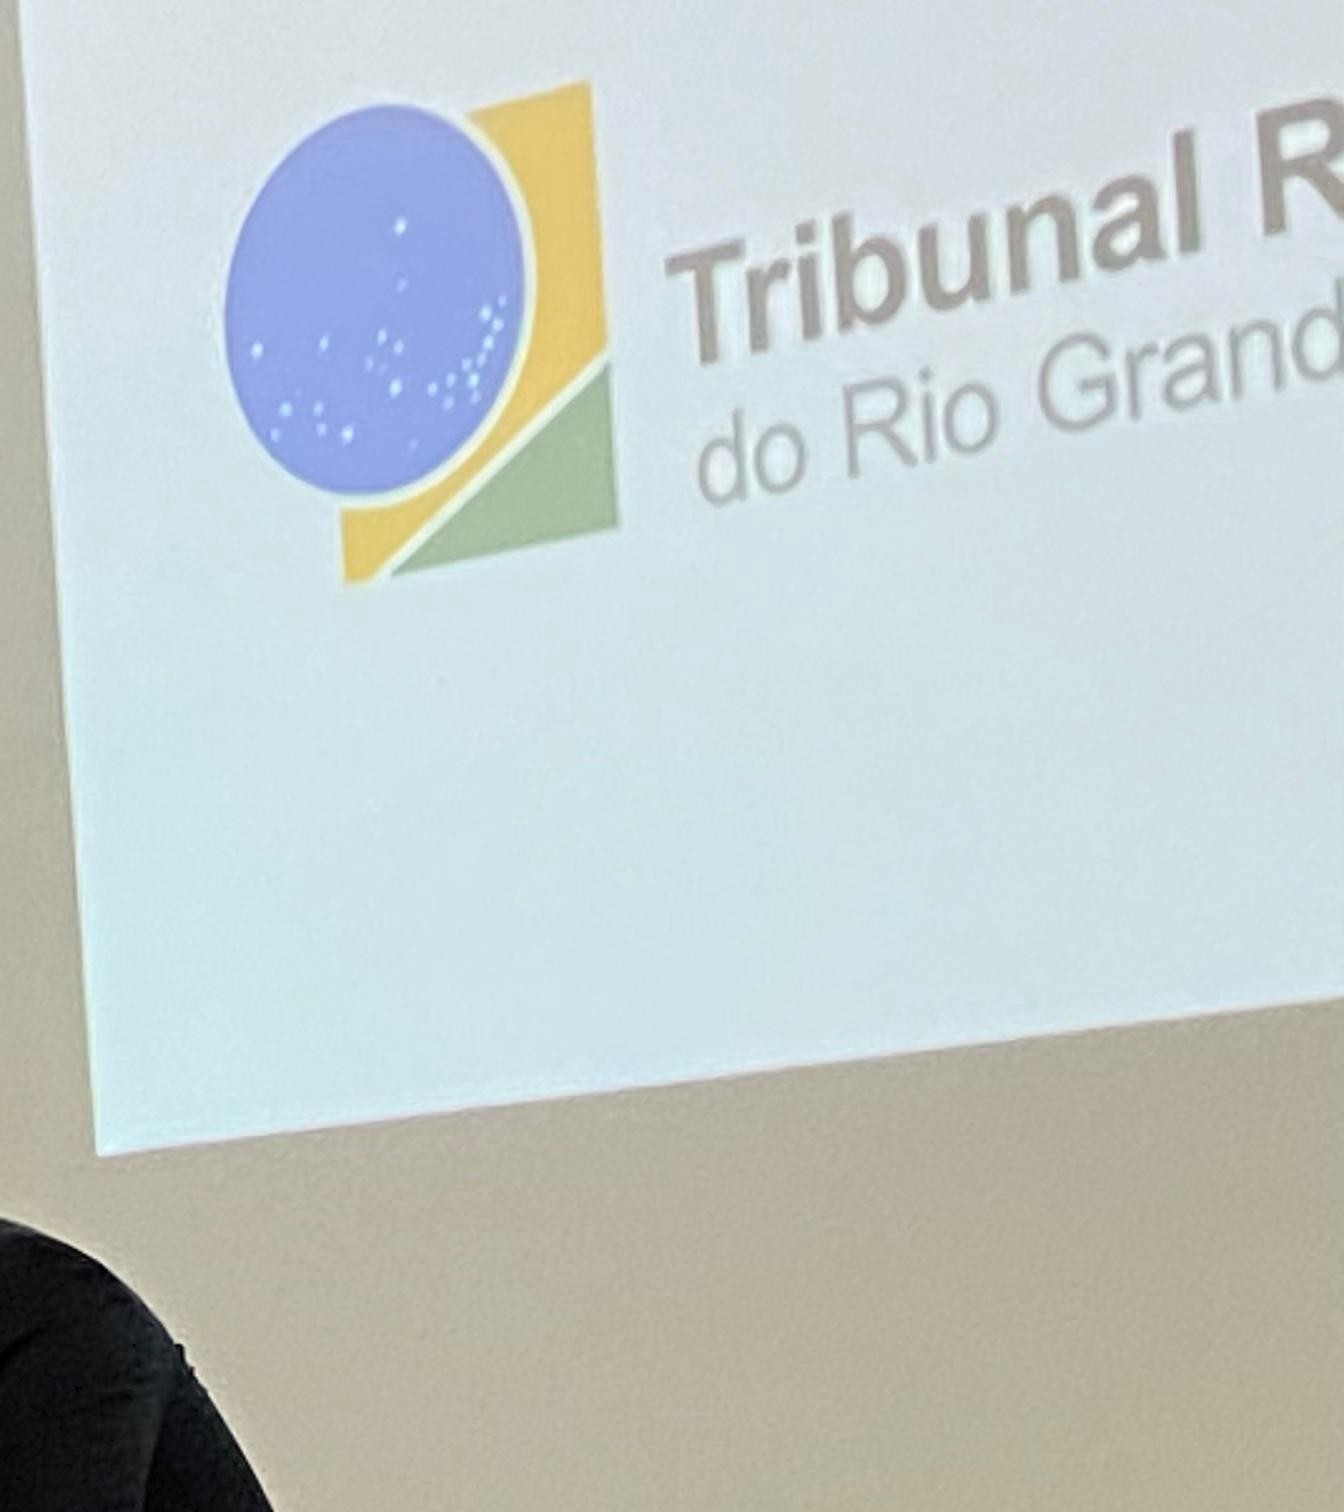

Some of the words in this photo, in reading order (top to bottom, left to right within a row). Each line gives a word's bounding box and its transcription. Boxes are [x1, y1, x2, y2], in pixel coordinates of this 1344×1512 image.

[665, 127, 1202, 365] Tribunal
[1256, 96, 1344, 237] R
[697, 409, 807, 507] do
[842, 366, 1000, 479] Rio
[1038, 275, 1344, 432] Grand
